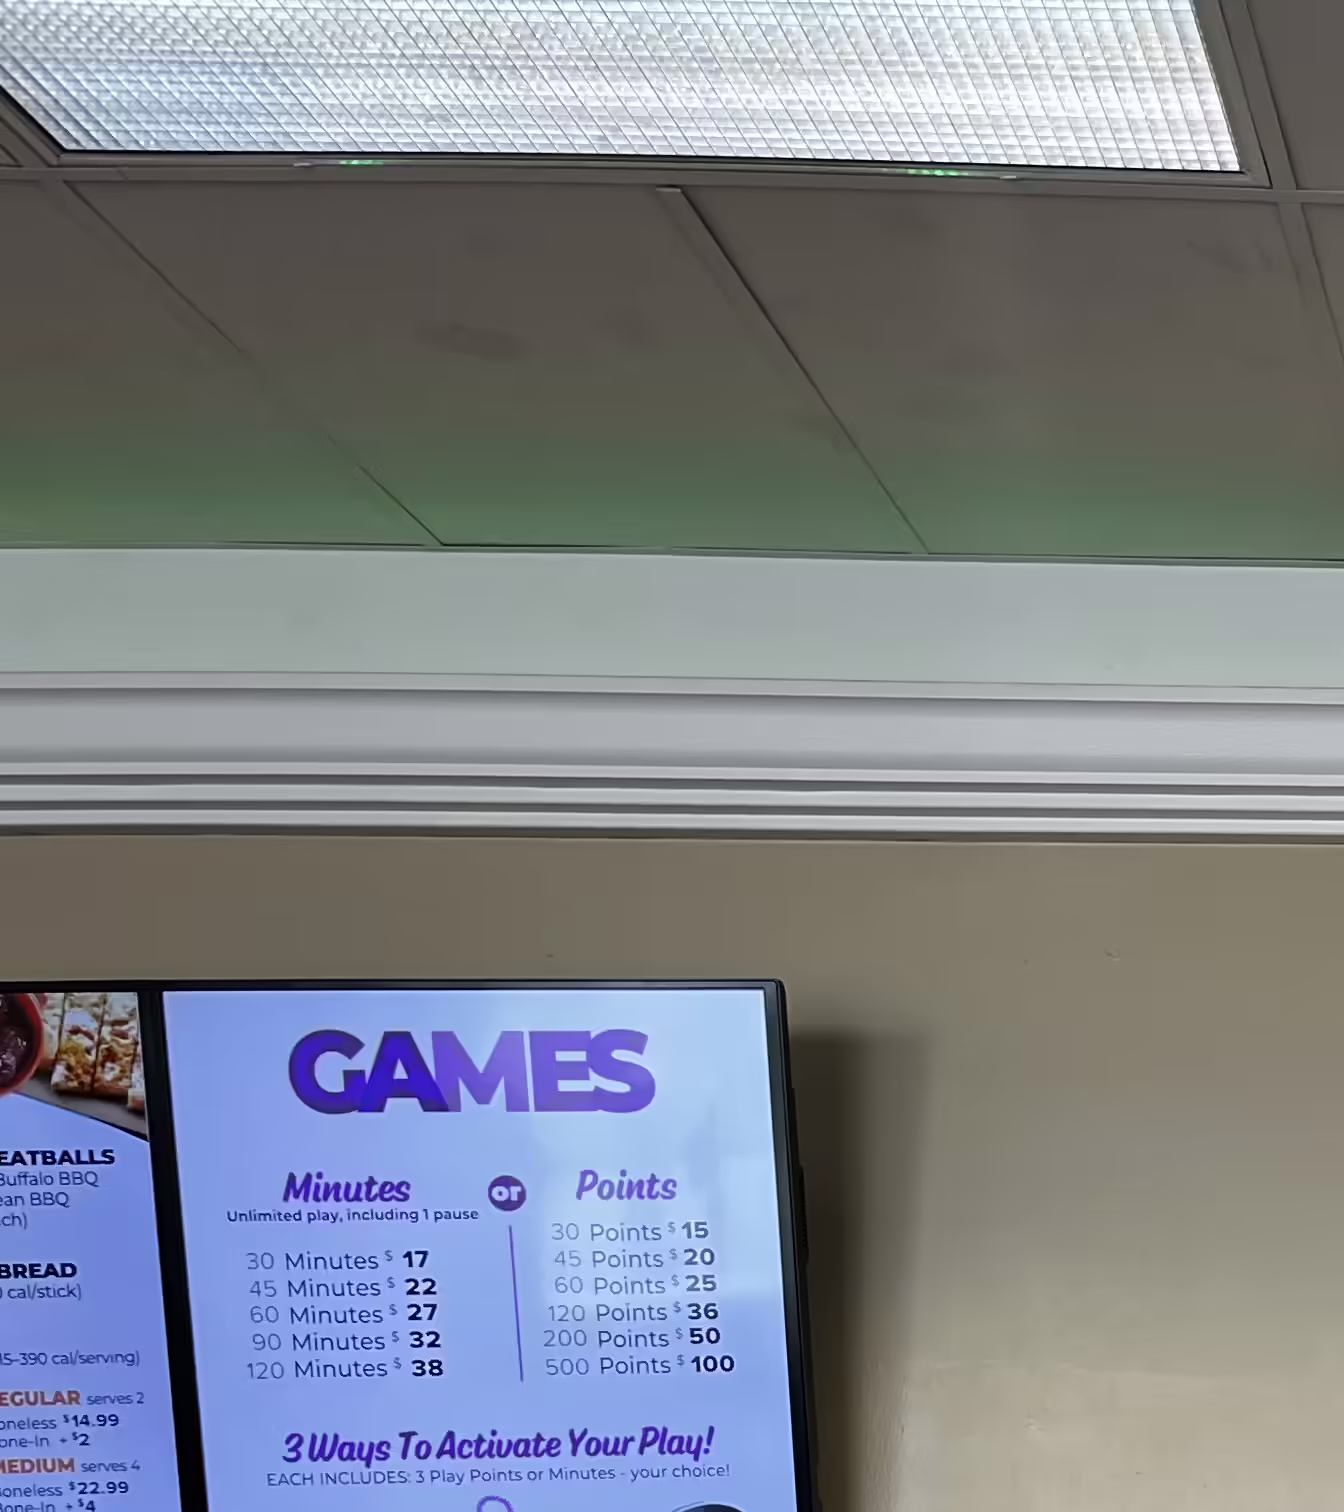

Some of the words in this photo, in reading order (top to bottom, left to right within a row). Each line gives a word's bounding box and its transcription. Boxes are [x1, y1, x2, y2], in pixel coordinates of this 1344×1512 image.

[289, 1028, 656, 1115] GAMES
[59, 1171, 99, 1187] BBQ
[282, 1171, 411, 1203] Minutes
[575, 1169, 678, 1201] Points
[30, 1191, 70, 1208] BBQ
[491, 1185, 522, 1202] or
[227, 1209, 302, 1222] Unlimited
[307, 1210, 343, 1224] play,
[346, 1208, 419, 1223] including
[434, 1210, 479, 1223] pause
[551, 1222, 580, 1241] 30
[590, 1222, 662, 1242] Points
[247, 1252, 274, 1270] 30
[285, 1251, 379, 1270] Minutes
[554, 1250, 582, 1268] 45
[592, 1249, 664, 1269] Points
[7, 1283, 82, 1300] cal/stick)
[250, 1280, 277, 1298] 45
[287, 1278, 381, 1297] Minutes
[554, 1276, 583, 1294] 60
[594, 1276, 666, 1295] Points
[250, 1305, 279, 1324] 60
[290, 1305, 384, 1325] Minutes
[547, 1304, 586, 1322] 120
[596, 1303, 668, 1322] Points
[252, 1333, 281, 1351] 90
[292, 1332, 386, 1351] Minutes
[543, 1329, 587, 1348] 200
[598, 1329, 670, 1349] Points
[52, 1350, 140, 1367] cal/serving)
[545, 1358, 590, 1376] 500
[600, 1356, 672, 1375] Points
[247, 1361, 284, 1380] 120
[294, 1359, 388, 1378] Minutes
[86, 1394, 133, 1405] serves
[136, 1392, 145, 1404] 2
[63, 1414, 119, 1427] $14.99
[283, 1433, 303, 1462] 3
[308, 1432, 391, 1468] Ways
[399, 1430, 432, 1461] To
[436, 1427, 561, 1460] Activate
[569, 1428, 635, 1457] Your
[638, 1425, 715, 1463] Play!
[81, 1461, 127, 1473] serves
[131, 1460, 141, 1471] 4
[267, 1471, 316, 1487] EACH
[320, 1470, 411, 1486] INCLUDES:
[415, 1469, 426, 1484] 3
[430, 1468, 464, 1487] Play
[469, 1467, 523, 1483] Points
[528, 1470, 543, 1482] or
[549, 1466, 615, 1481] Minutes
[630, 1466, 669, 1483] your
[674, 1463, 730, 1479] choice!
[69, 1481, 129, 1495] $22.99
